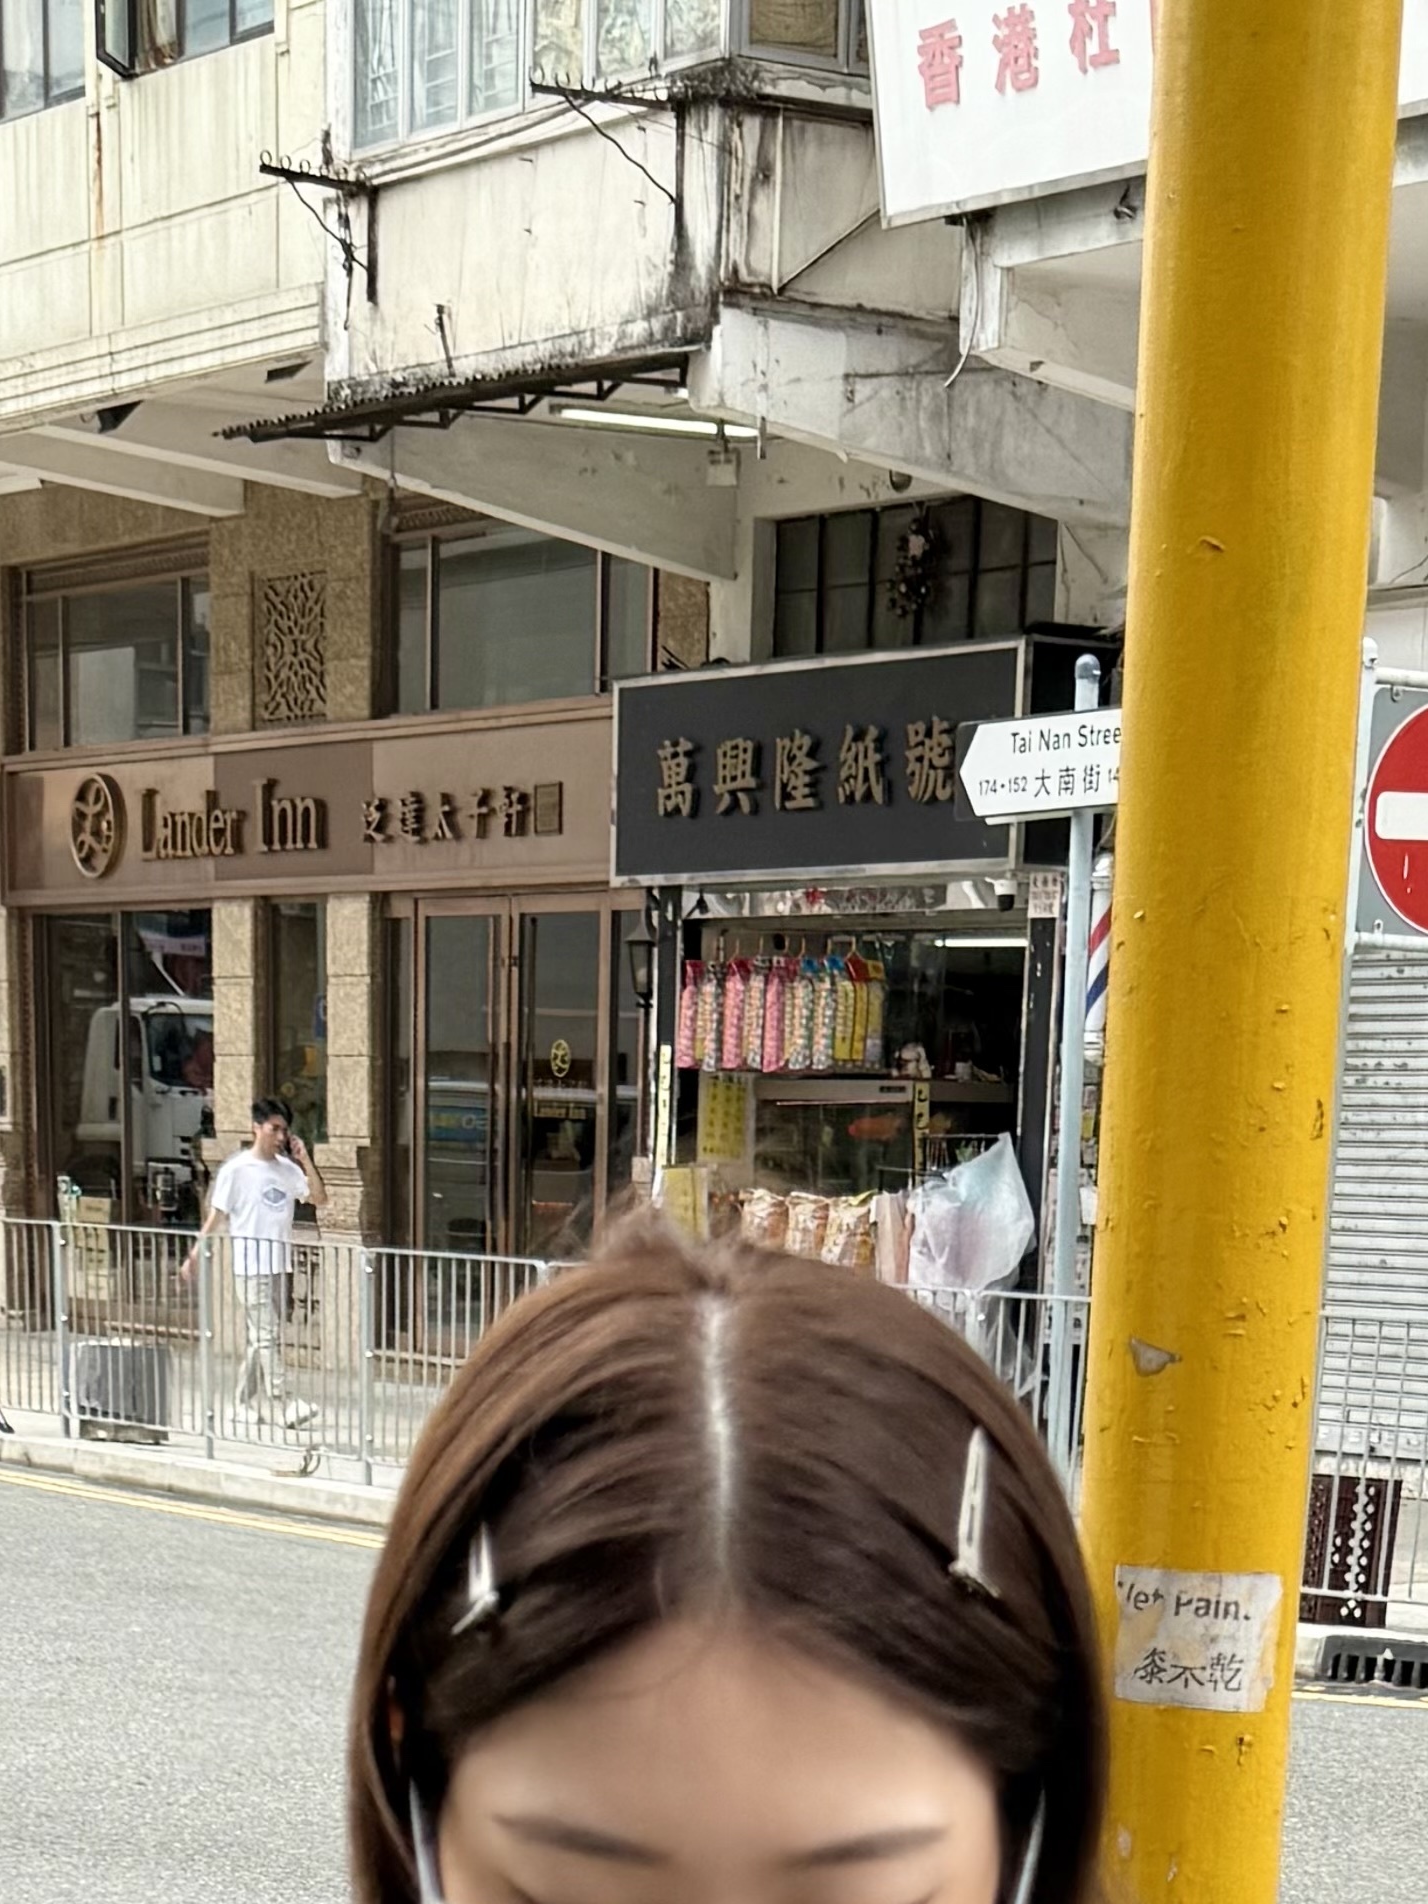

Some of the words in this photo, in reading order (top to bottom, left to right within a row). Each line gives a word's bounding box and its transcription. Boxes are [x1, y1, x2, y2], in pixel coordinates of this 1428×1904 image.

[1010, 730, 1032, 754] Tai
[1038, 728, 1071, 752] Nan
[1078, 724, 1122, 748] Stree
[657, 714, 956, 817] 萬興隆紙號
[1034, 764, 1101, 798] 大南街
[140, 788, 244, 861] Lander
[252, 778, 322, 854] Inn
[1174, 1591, 1251, 1620] Pain
